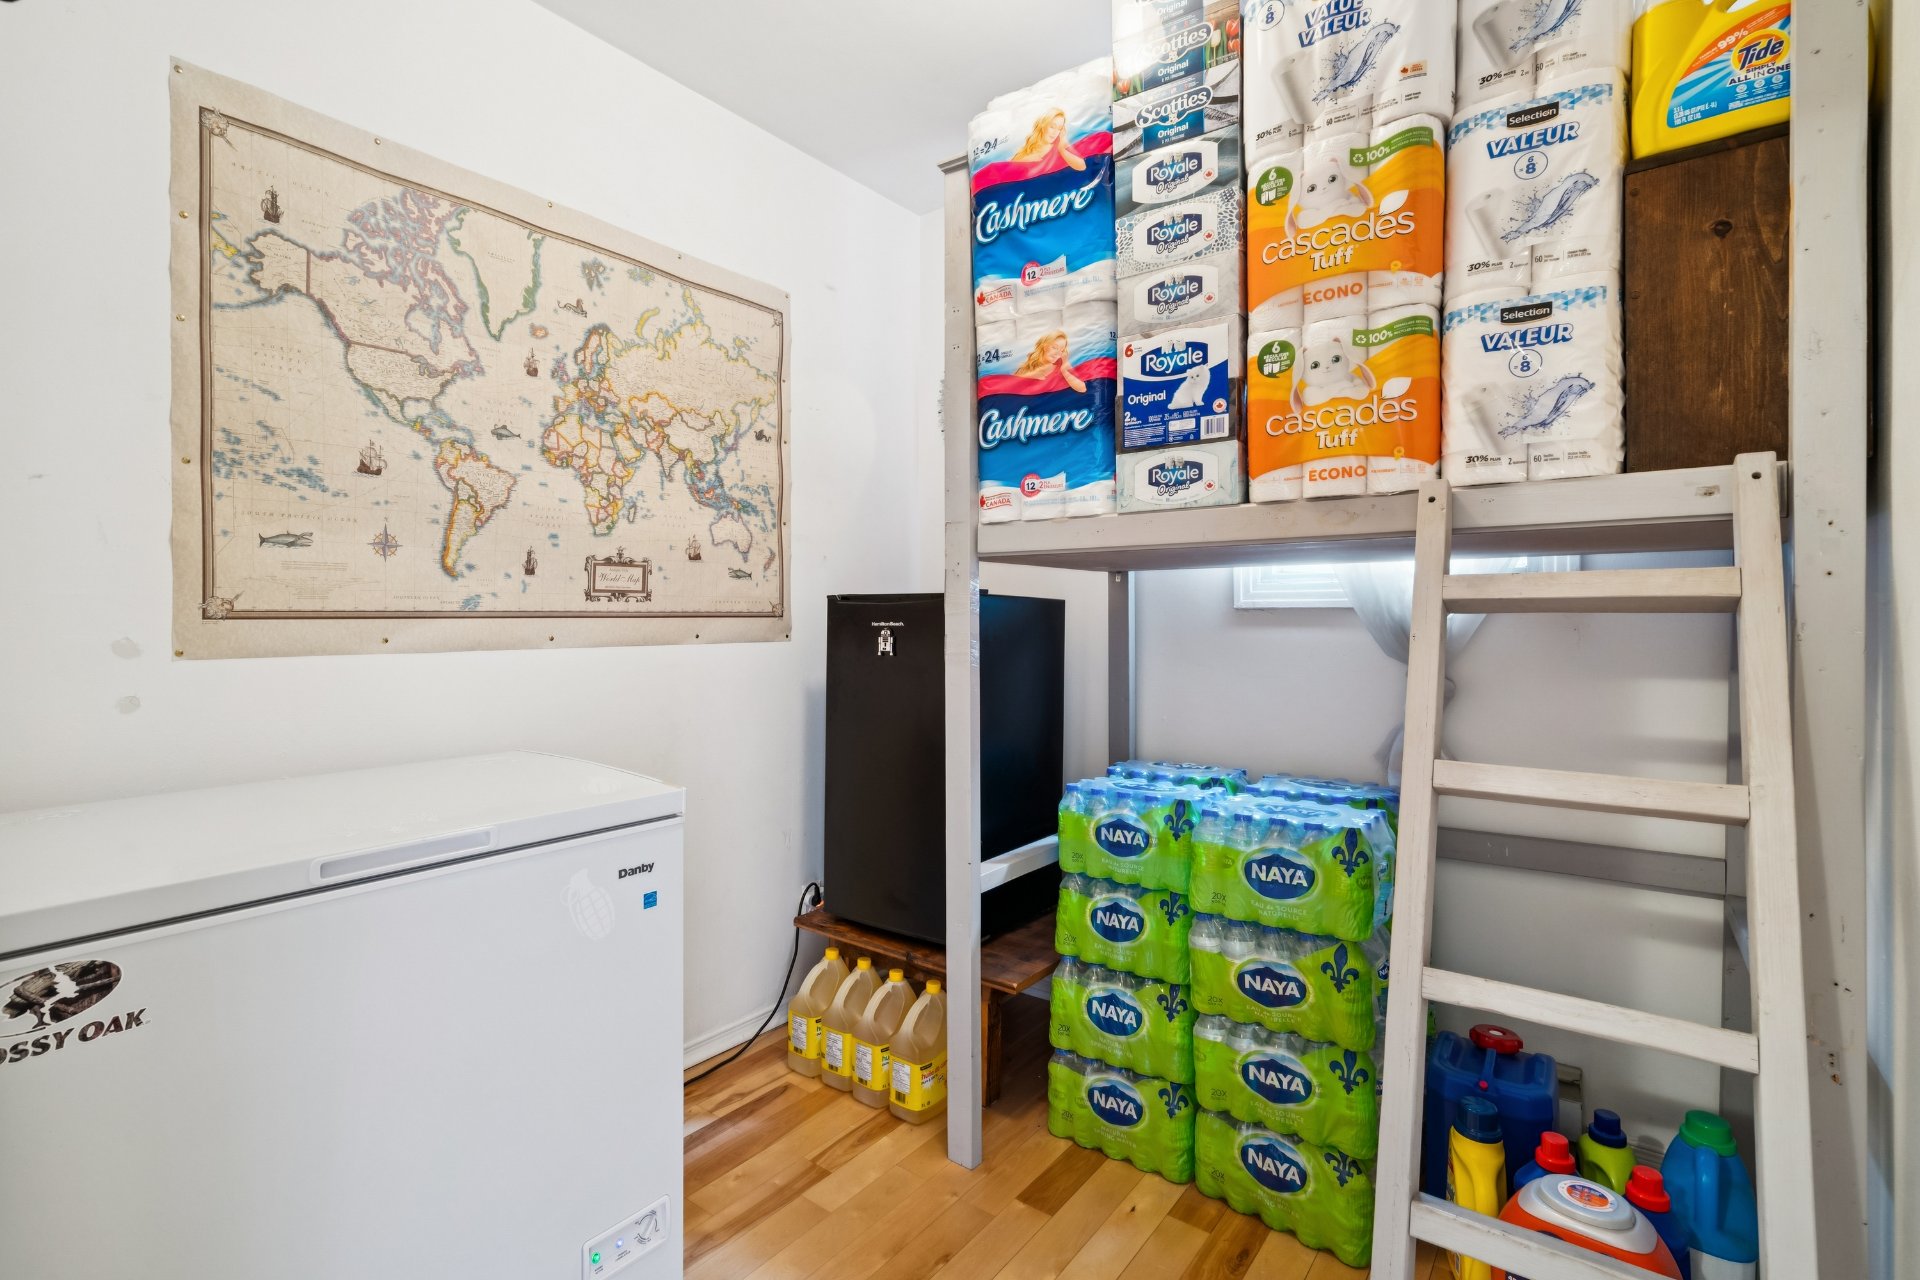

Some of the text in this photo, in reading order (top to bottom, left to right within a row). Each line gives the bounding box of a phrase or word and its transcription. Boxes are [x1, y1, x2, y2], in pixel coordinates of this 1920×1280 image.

[1265, 12, 1275, 25] 8
[1297, 8, 1372, 48] VALEUR
[1717, 28, 1748, 50] 99%
[1738, 36, 1785, 71] Tide
[1157, 60, 1189, 77] Original
[1728, 63, 1790, 86] ALL IN ONE
[1745, 61, 1776, 74] SIMPLY
[1479, 71, 1503, 86] 30%
[1138, 92, 1208, 127] Scotties
[1508, 107, 1557, 126] Selection
[1157, 121, 1189, 139] Original
[1486, 121, 1580, 159] VALEUR
[1366, 146, 1391, 162] 100%
[1150, 158, 1198, 182] Royale
[1268, 168, 1277, 181] 6
[1525, 162, 1537, 175] 8
[1156, 174, 1190, 195] Original
[975, 190, 1095, 244] Cashmere
[1151, 219, 1199, 243] Royale
[1262, 211, 1416, 266] cascades
[1156, 236, 1190, 254] Original
[1310, 244, 1354, 272] Tuff
[1467, 260, 1491, 272] 30%
[1534, 254, 1543, 263] 60
[1026, 270, 1037, 281] 12
[988, 289, 1012, 302] CANADA
[1151, 280, 1199, 304] Royale
[1303, 282, 1363, 306] ECONO
[1157, 296, 1190, 315] Original
[1502, 307, 1550, 321] Selection
[1369, 329, 1393, 344] 100%
[1480, 323, 1574, 353] VALEUR
[984, 348, 999, 364] 24
[1124, 343, 1134, 358] 6
[1271, 341, 1281, 354] 6
[1145, 347, 1204, 375] Royale
[1519, 360, 1531, 372] 8
[1127, 389, 1166, 407] Original
[1124, 411, 1131, 422] 2
[1265, 394, 1418, 437] cascades
[979, 405, 1094, 450] Cashmere
[1315, 427, 1358, 450] Tuff
[1465, 454, 1489, 464] 30%
[1533, 454, 1542, 463] 60
[1152, 467, 1200, 486] Royale
[1308, 465, 1367, 483] ECONO
[1026, 482, 1036, 491] 12
[1157, 481, 1191, 497] Original
[985, 498, 1012, 508] CANADA
[599, 572, 640, 586] World Map
[1100, 826, 1145, 848] NAYA
[618, 862, 655, 880] Danby
[1250, 862, 1309, 887] NAYA
[1276, 905, 1308, 916] SOURCE
[1096, 910, 1140, 932] NAYA
[1243, 973, 1301, 998] NAYA
[1090, 1000, 1138, 1028] NAYA
[77, 1007, 147, 1042] OAK
[1248, 1064, 1306, 1097] NAYA
[1093, 1089, 1138, 1120] NAYA
[1248, 1147, 1302, 1186] NAYA
